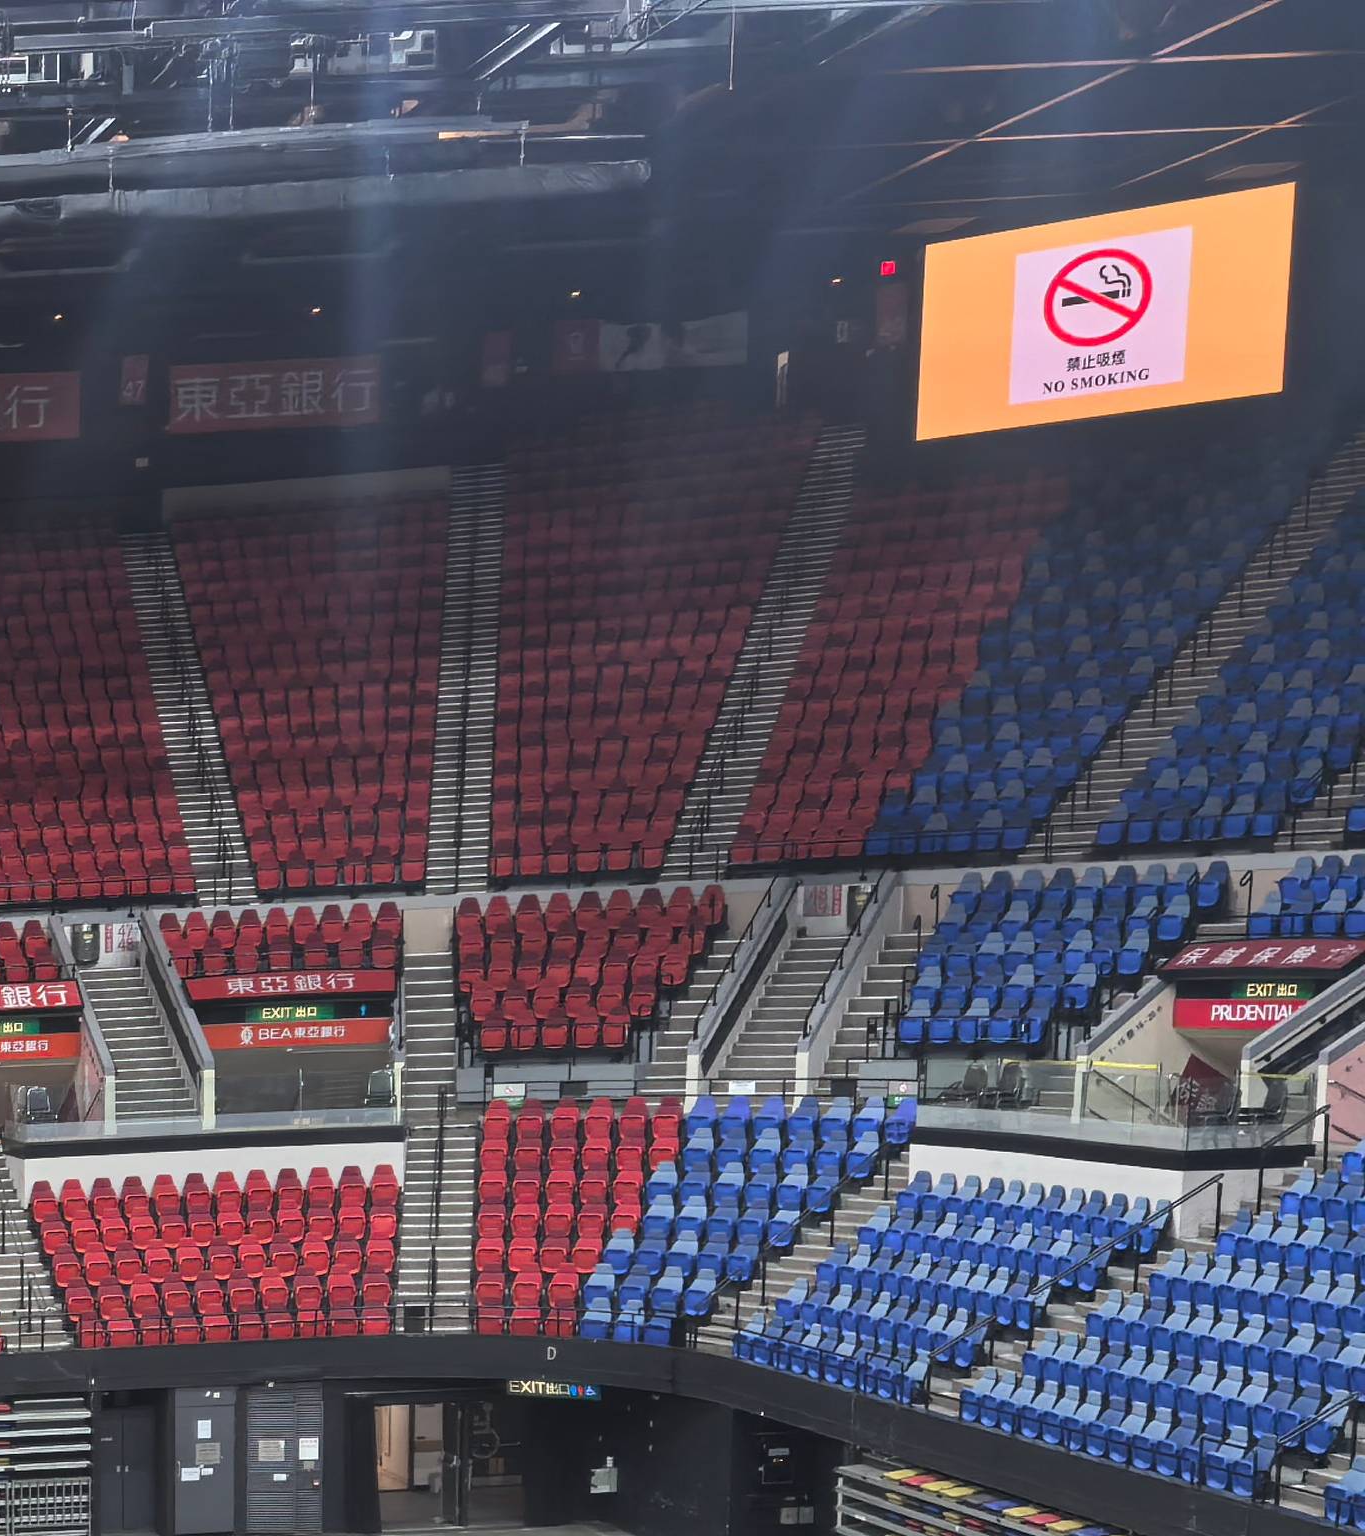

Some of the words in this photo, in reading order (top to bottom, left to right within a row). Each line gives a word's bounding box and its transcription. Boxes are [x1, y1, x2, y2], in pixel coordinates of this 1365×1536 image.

[1067, 349, 1126, 371] 禁止吸煙
[1042, 380, 1065, 394] NO
[1070, 368, 1150, 391] SMOKING
[170, 368, 372, 423] 東亞銀行
[226, 973, 355, 995] 東亞銀行
[1247, 983, 1275, 997] EXIT
[1277, 984, 1298, 996] 出口
[262, 1007, 293, 1019] EXIT
[295, 1006, 317, 1018] 出口
[3, 1022, 23, 1034] 出口
[259, 1028, 292, 1040] BEA
[294, 1026, 345, 1038] 東亞銀行
[0, 1040, 49, 1052] 東亞銀行
[547, 1346, 557, 1361] D
[509, 1381, 545, 1394] EXIT
